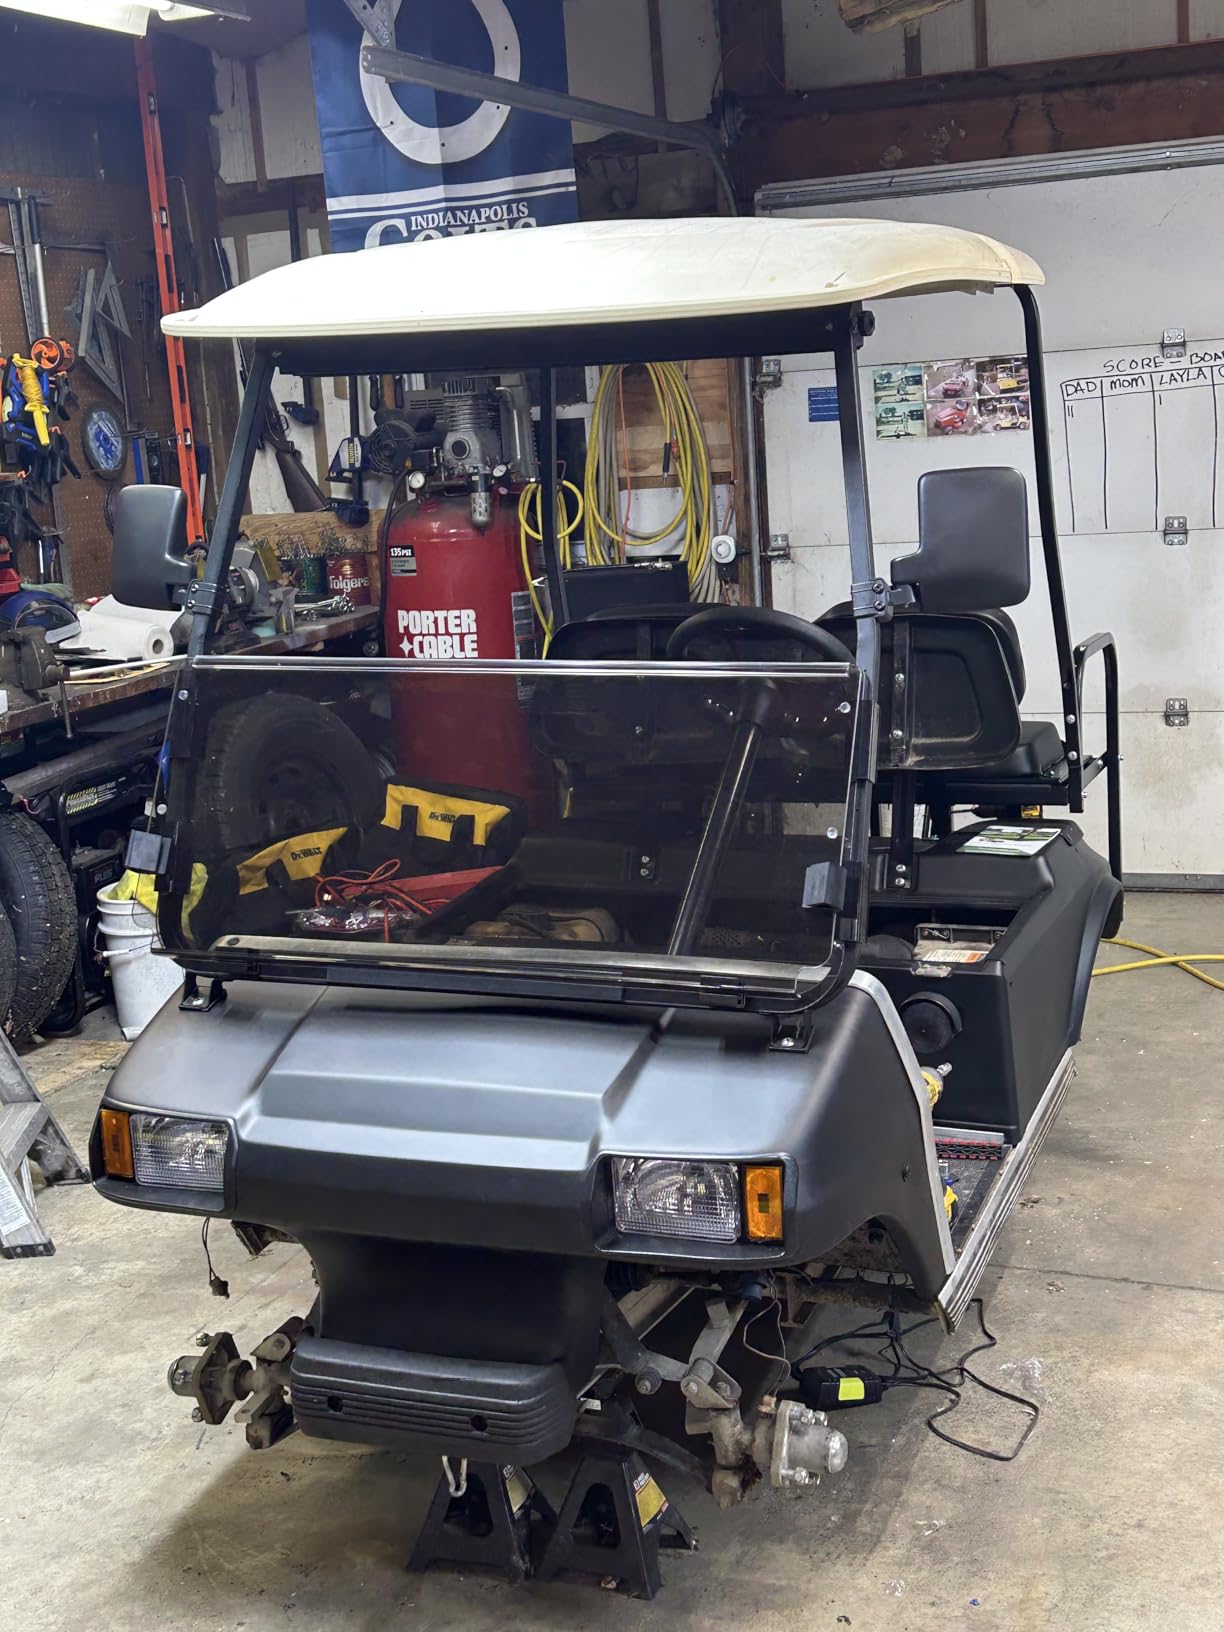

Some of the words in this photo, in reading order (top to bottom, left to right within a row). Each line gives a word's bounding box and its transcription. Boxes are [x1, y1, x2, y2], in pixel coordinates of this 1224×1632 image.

[410, 201, 528, 231] INDIANAPOLIS
[1103, 355, 1164, 373] SCORE
[1190, 350, 1224, 365] BOA
[1160, 367, 1207, 385] LAYLA
[1065, 381, 1097, 397] DAD
[397, 609, 477, 635] PORTER
[412, 634, 479, 659] CABLE
